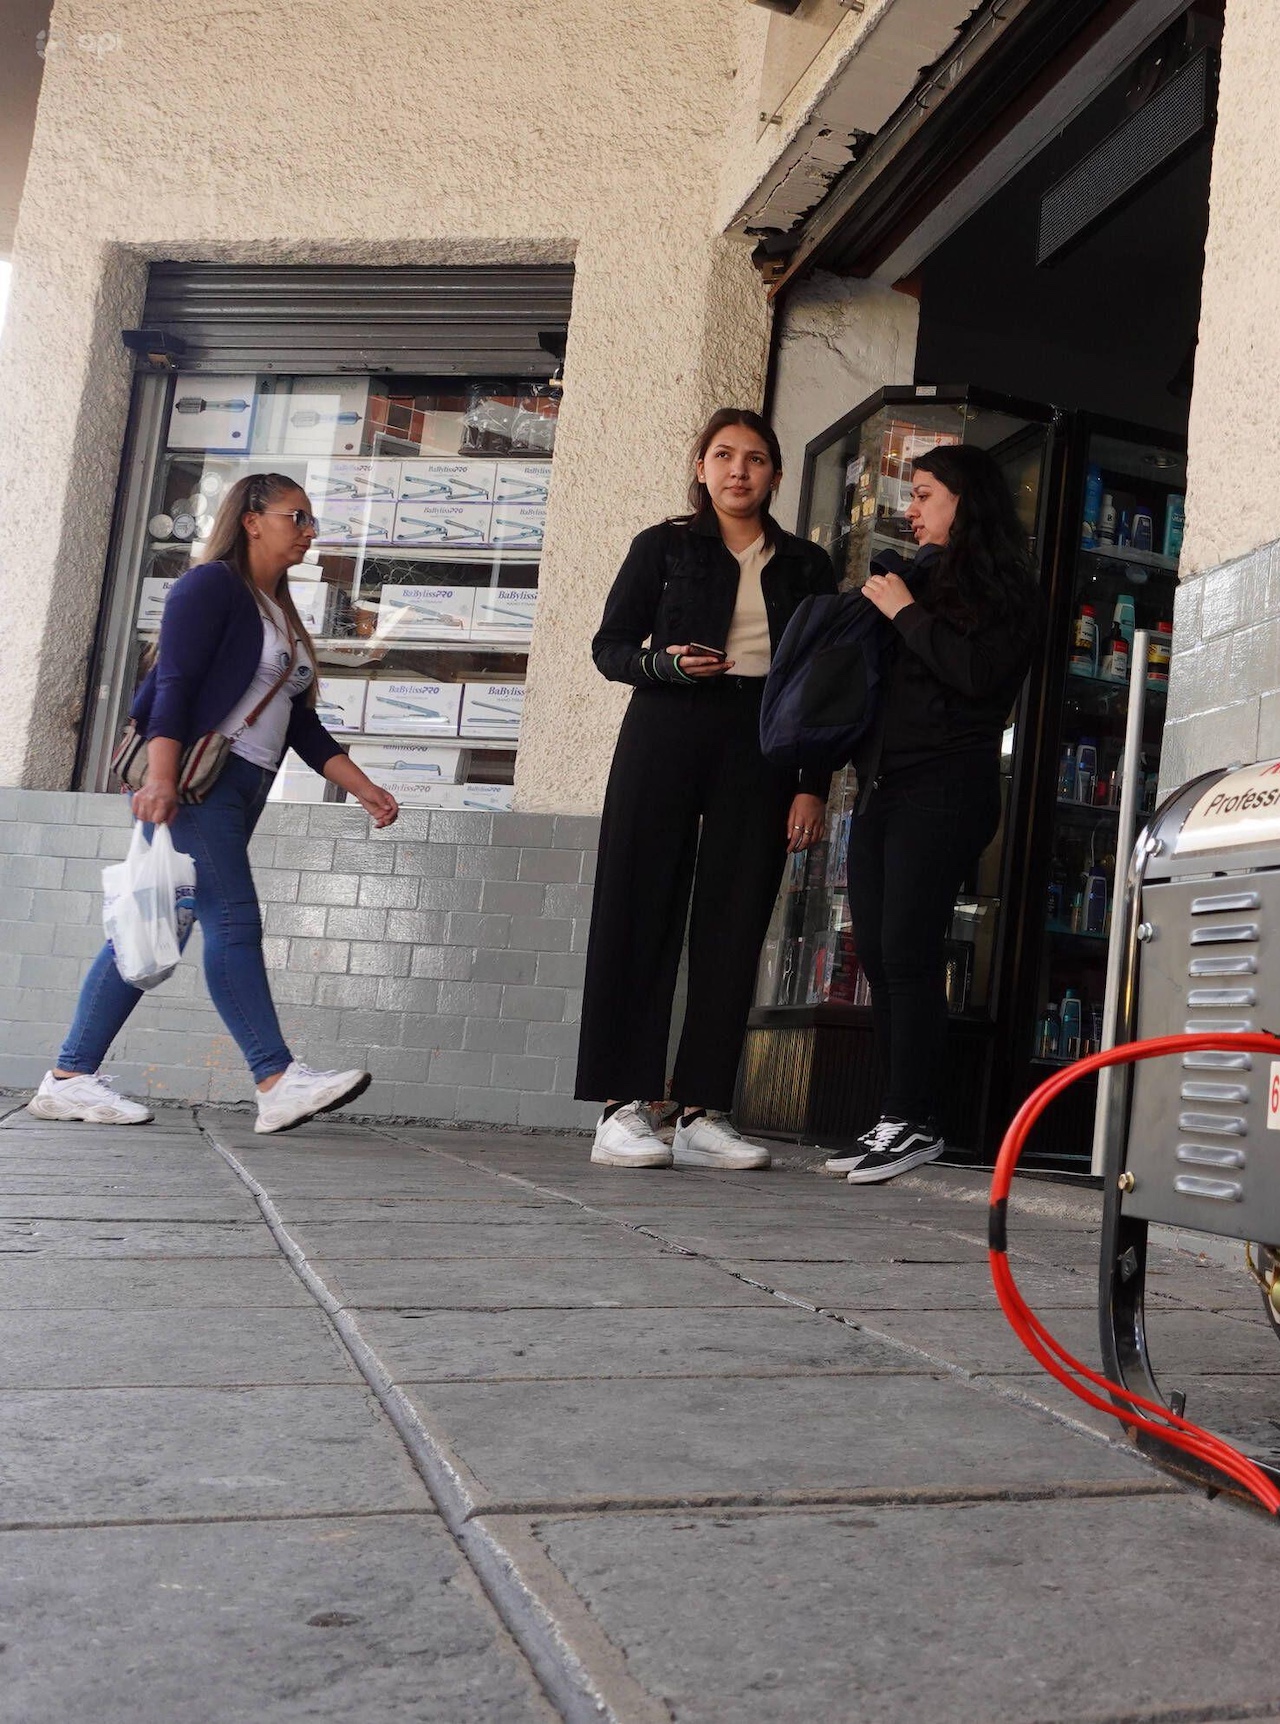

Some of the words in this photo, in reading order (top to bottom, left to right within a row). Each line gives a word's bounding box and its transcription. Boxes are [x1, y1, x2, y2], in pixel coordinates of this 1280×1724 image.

[428, 466, 468, 474] BaBylissPRO
[423, 507, 463, 515] BaBylissPRO
[402, 590, 453, 600] BaBylissPRO
[498, 590, 538, 602] BaByliss
[388, 685, 440, 694] BaBylissPRO
